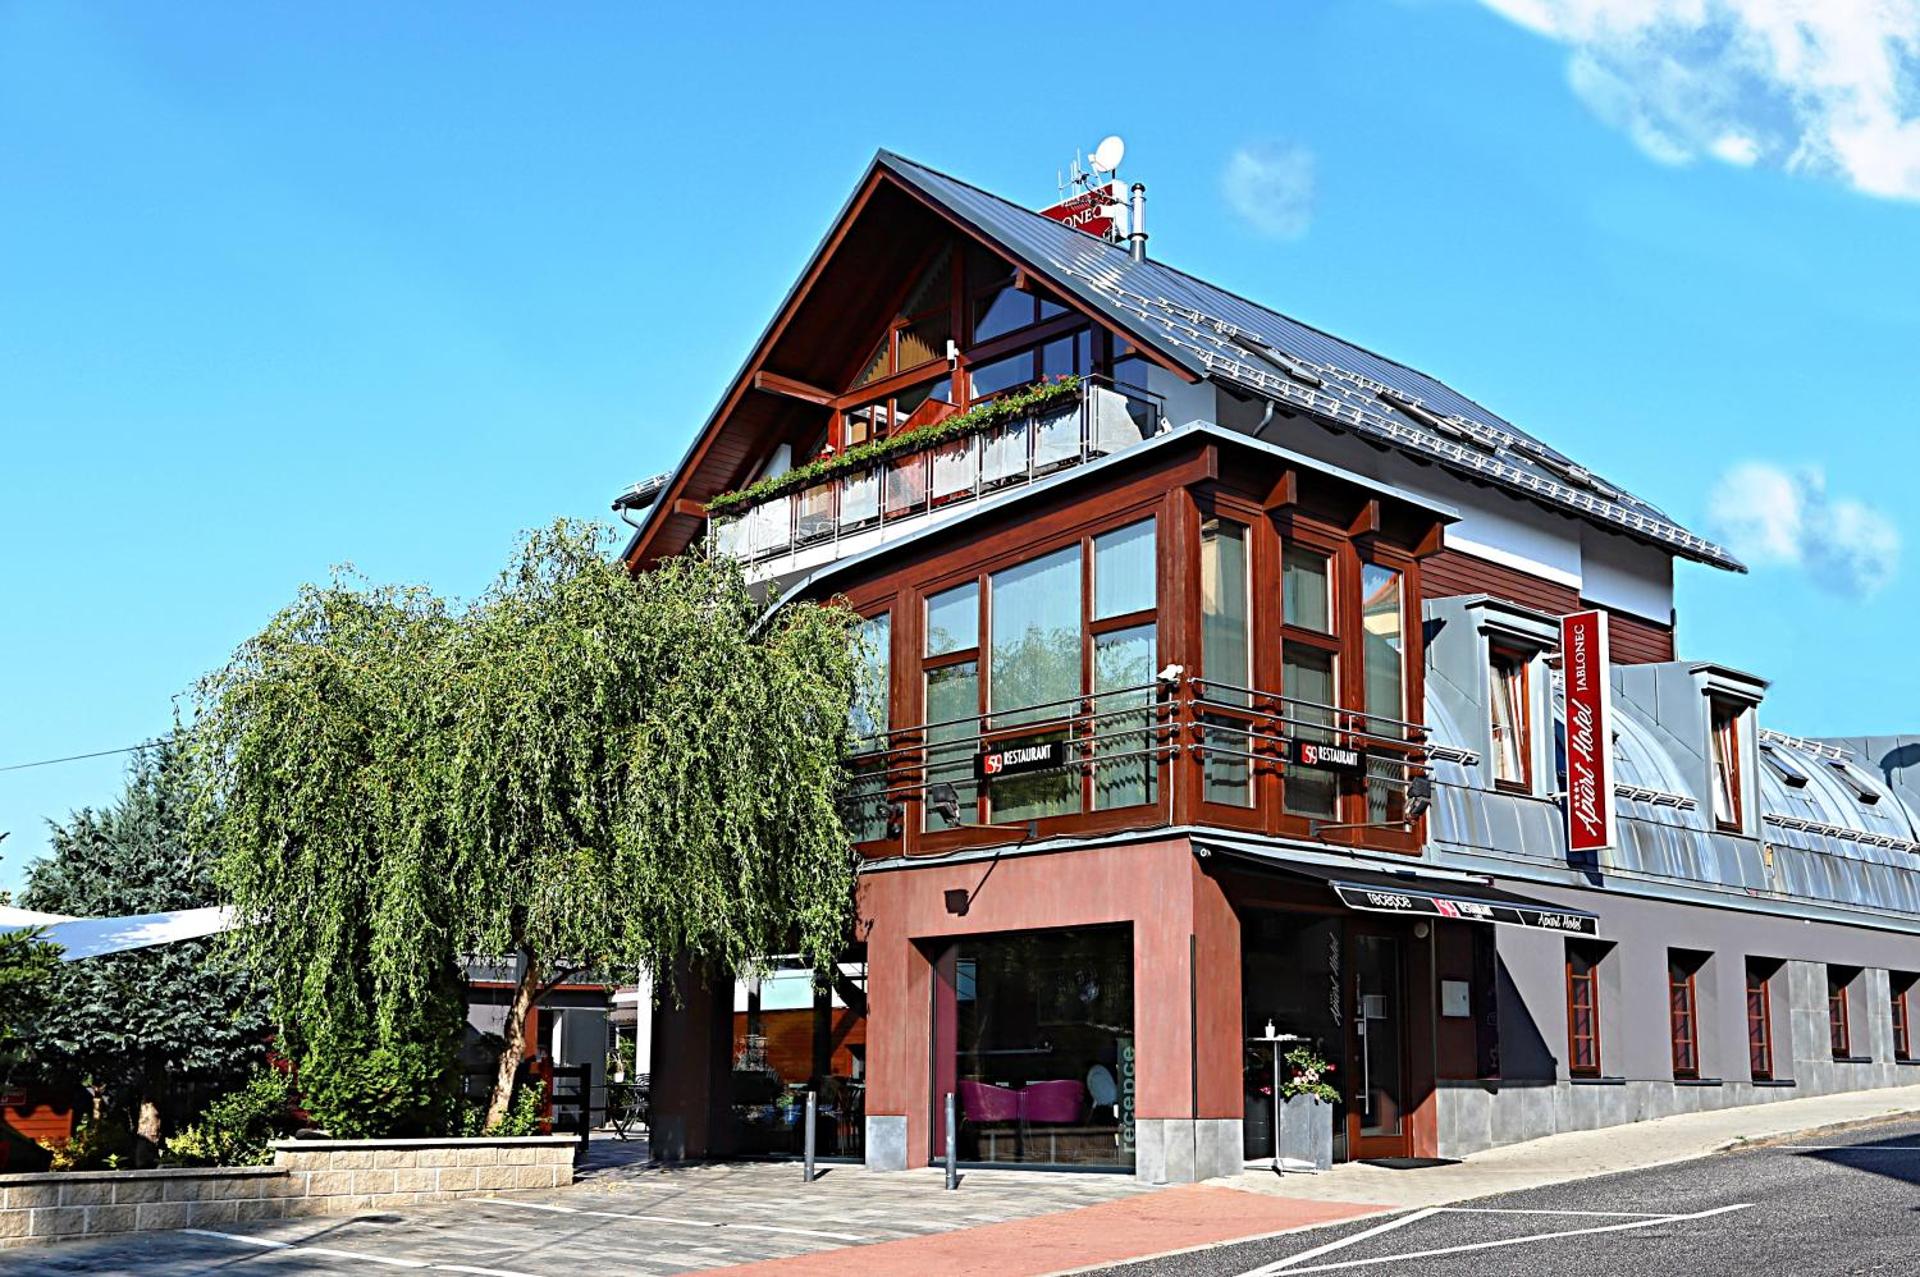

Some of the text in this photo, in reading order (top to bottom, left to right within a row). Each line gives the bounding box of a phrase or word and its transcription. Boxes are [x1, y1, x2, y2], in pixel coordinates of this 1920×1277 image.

[1571, 624, 1602, 837] Apart Hotel JABLONEC
[986, 744, 1051, 773] 59 RESTAURANT
[1303, 745, 1358, 766] 59 RESTAURANT
[1367, 892, 1412, 910] recepce
